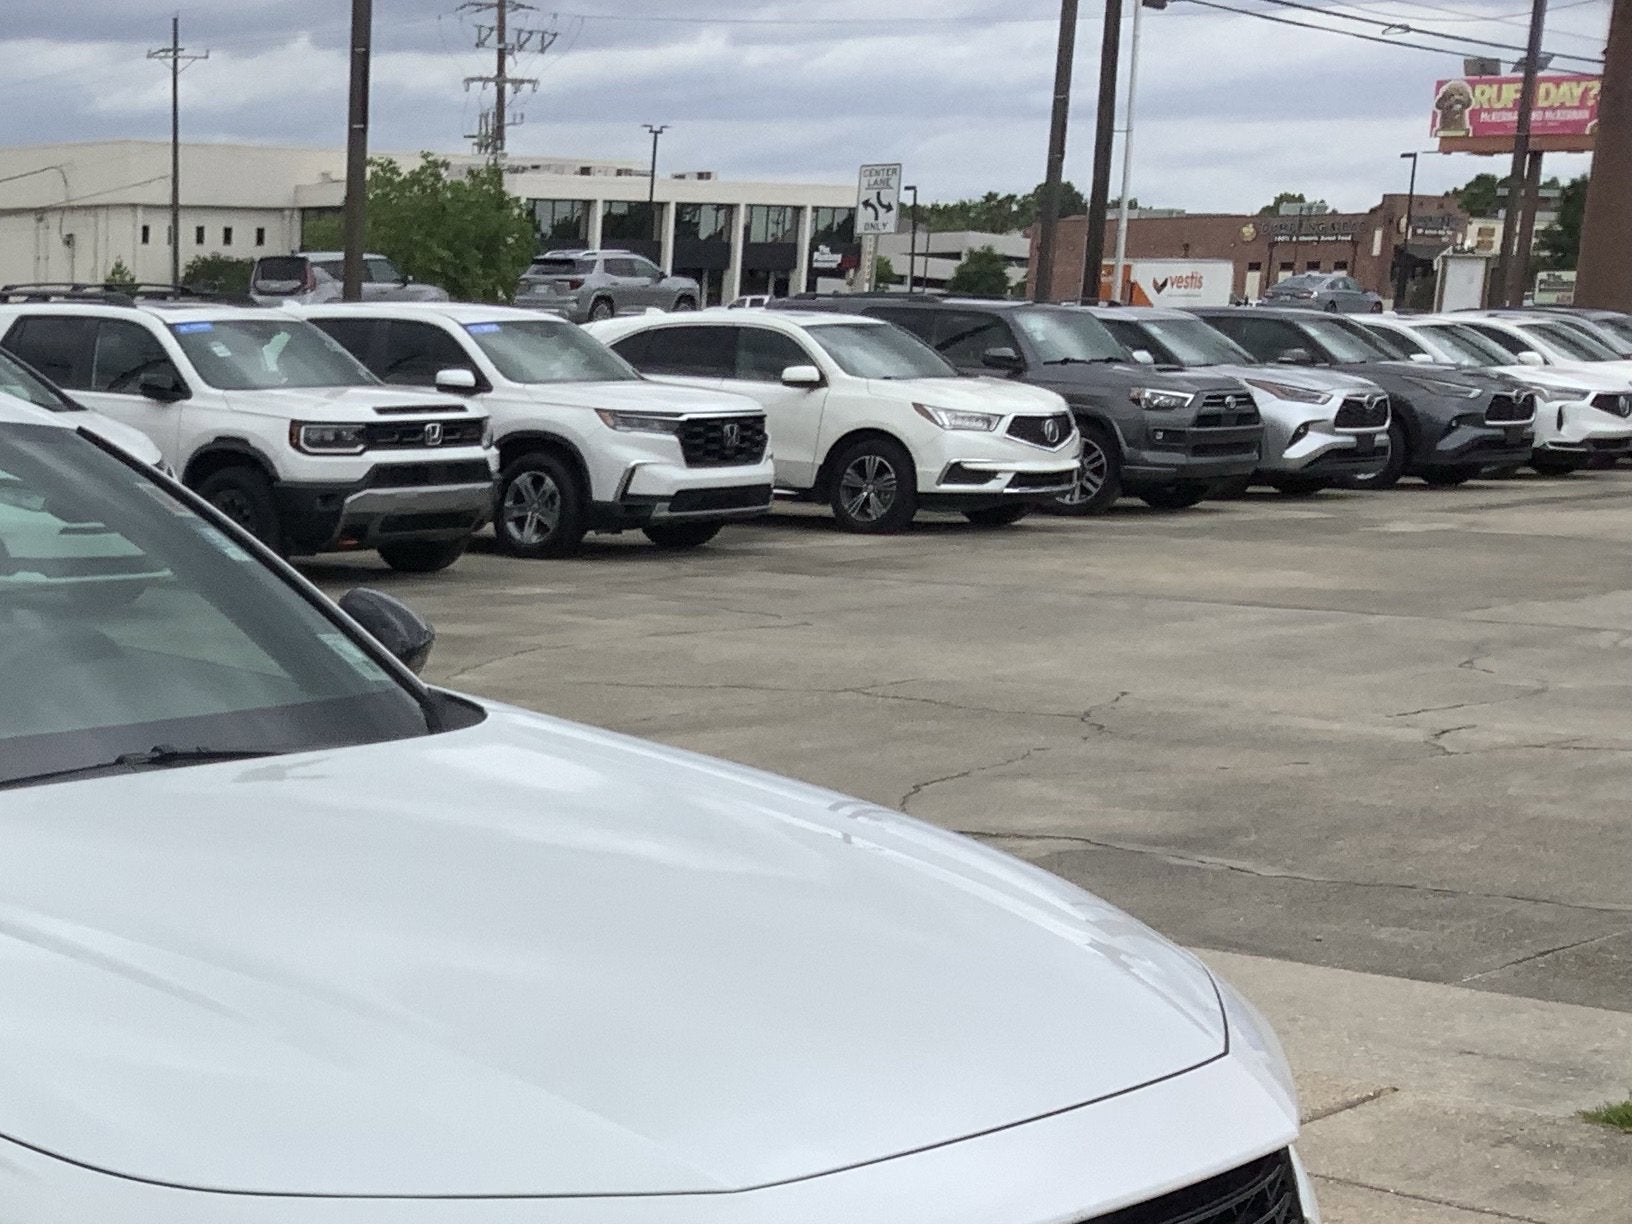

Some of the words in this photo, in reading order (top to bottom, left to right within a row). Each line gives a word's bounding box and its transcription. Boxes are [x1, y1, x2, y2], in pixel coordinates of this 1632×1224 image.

[1473, 82, 1523, 109] RUF
[863, 168, 897, 178] CENTER
[868, 178, 892, 188] LANE
[864, 222, 888, 231] ONLY
[1169, 271, 1204, 289] vestis
